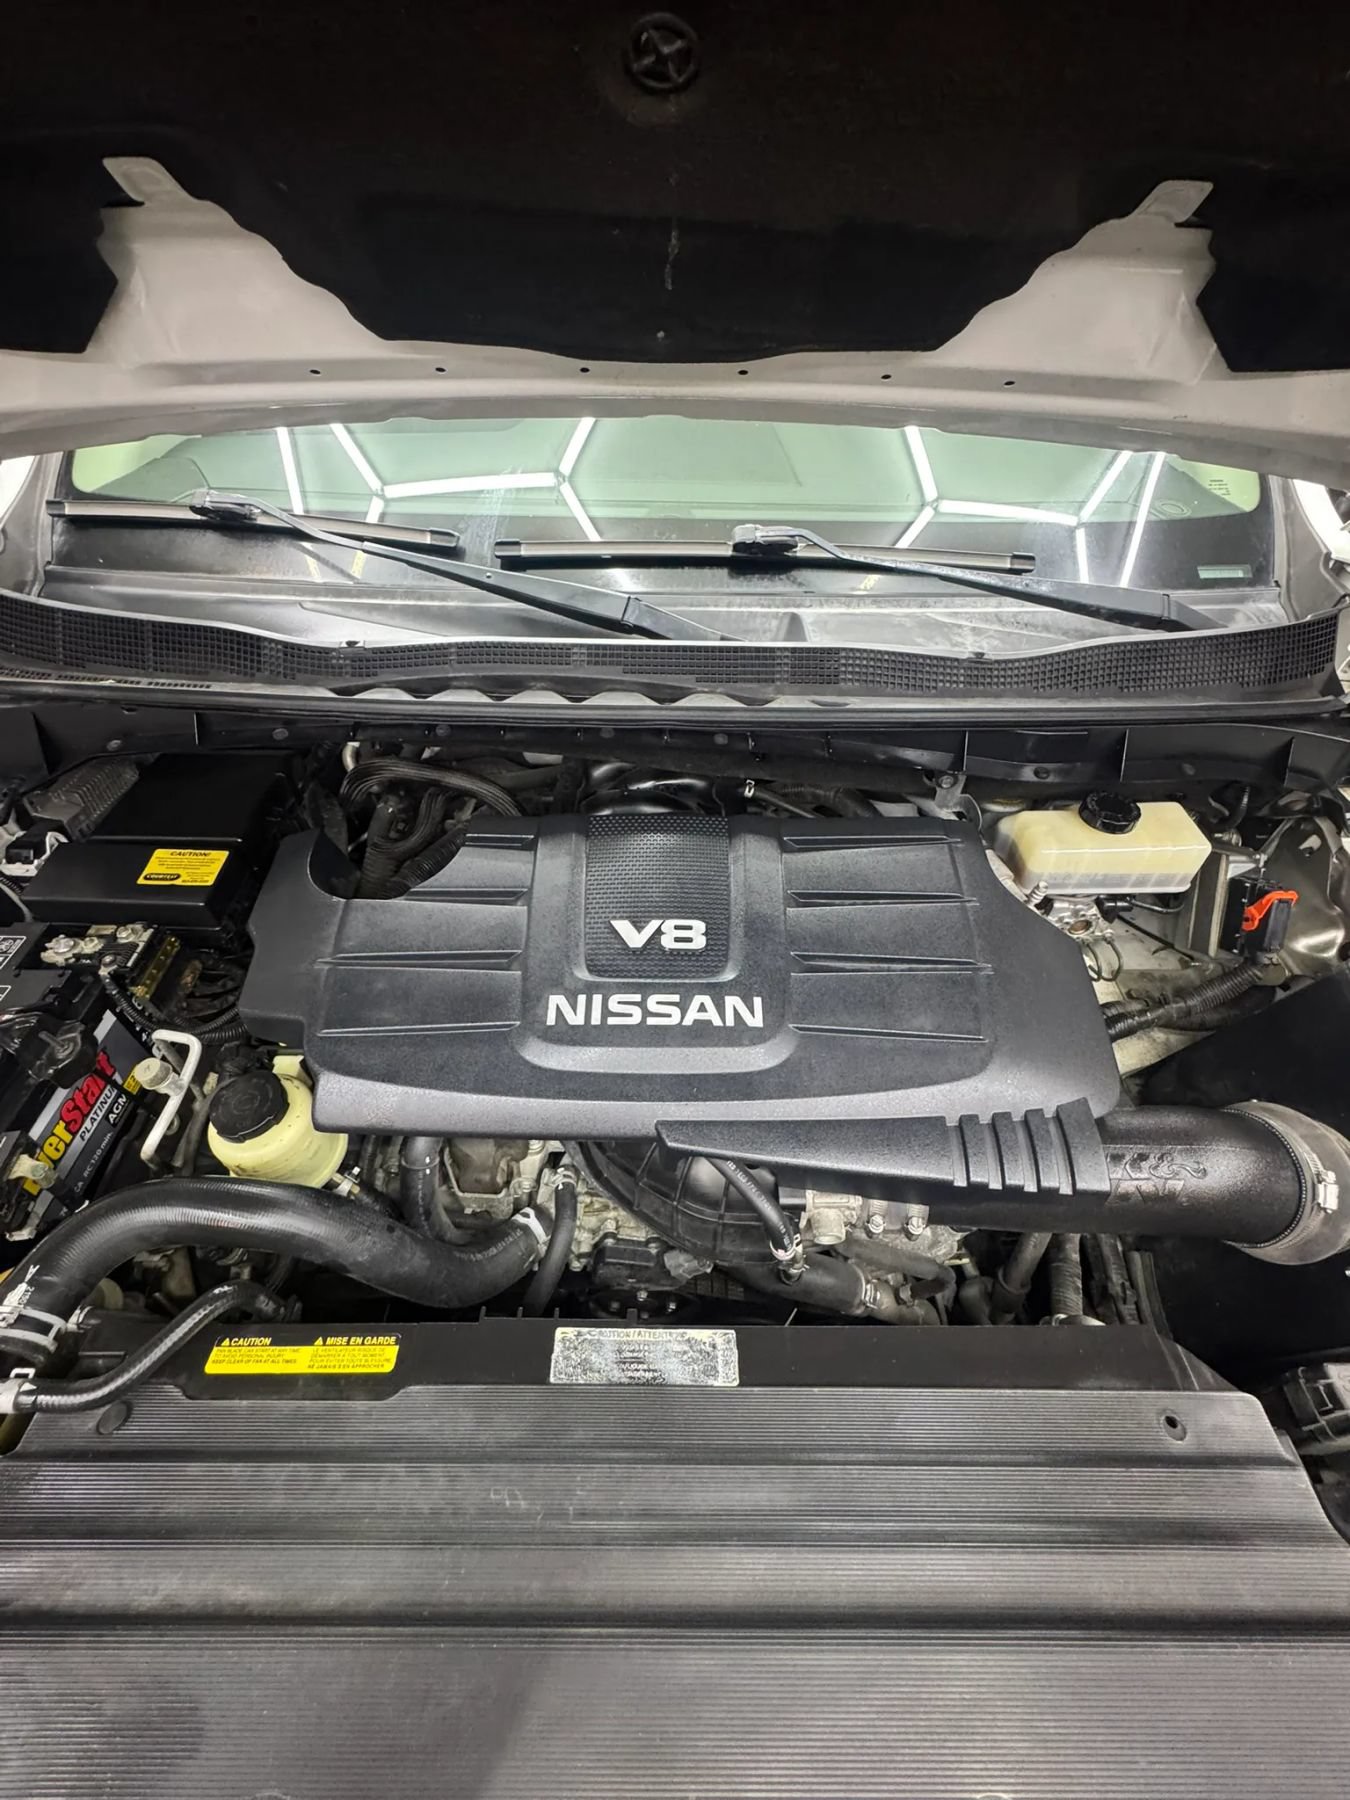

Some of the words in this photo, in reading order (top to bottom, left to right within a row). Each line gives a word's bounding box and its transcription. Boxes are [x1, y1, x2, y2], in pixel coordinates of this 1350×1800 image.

[610, 919, 707, 950] V8
[546, 993, 764, 1028] NISSAN
[79, 1085, 117, 1142] PLATINU
[230, 1337, 273, 1346] CAUTION
[325, 1336, 349, 1345] MISE
[349, 1336, 363, 1345] EN
[364, 1336, 397, 1345] GARDE
